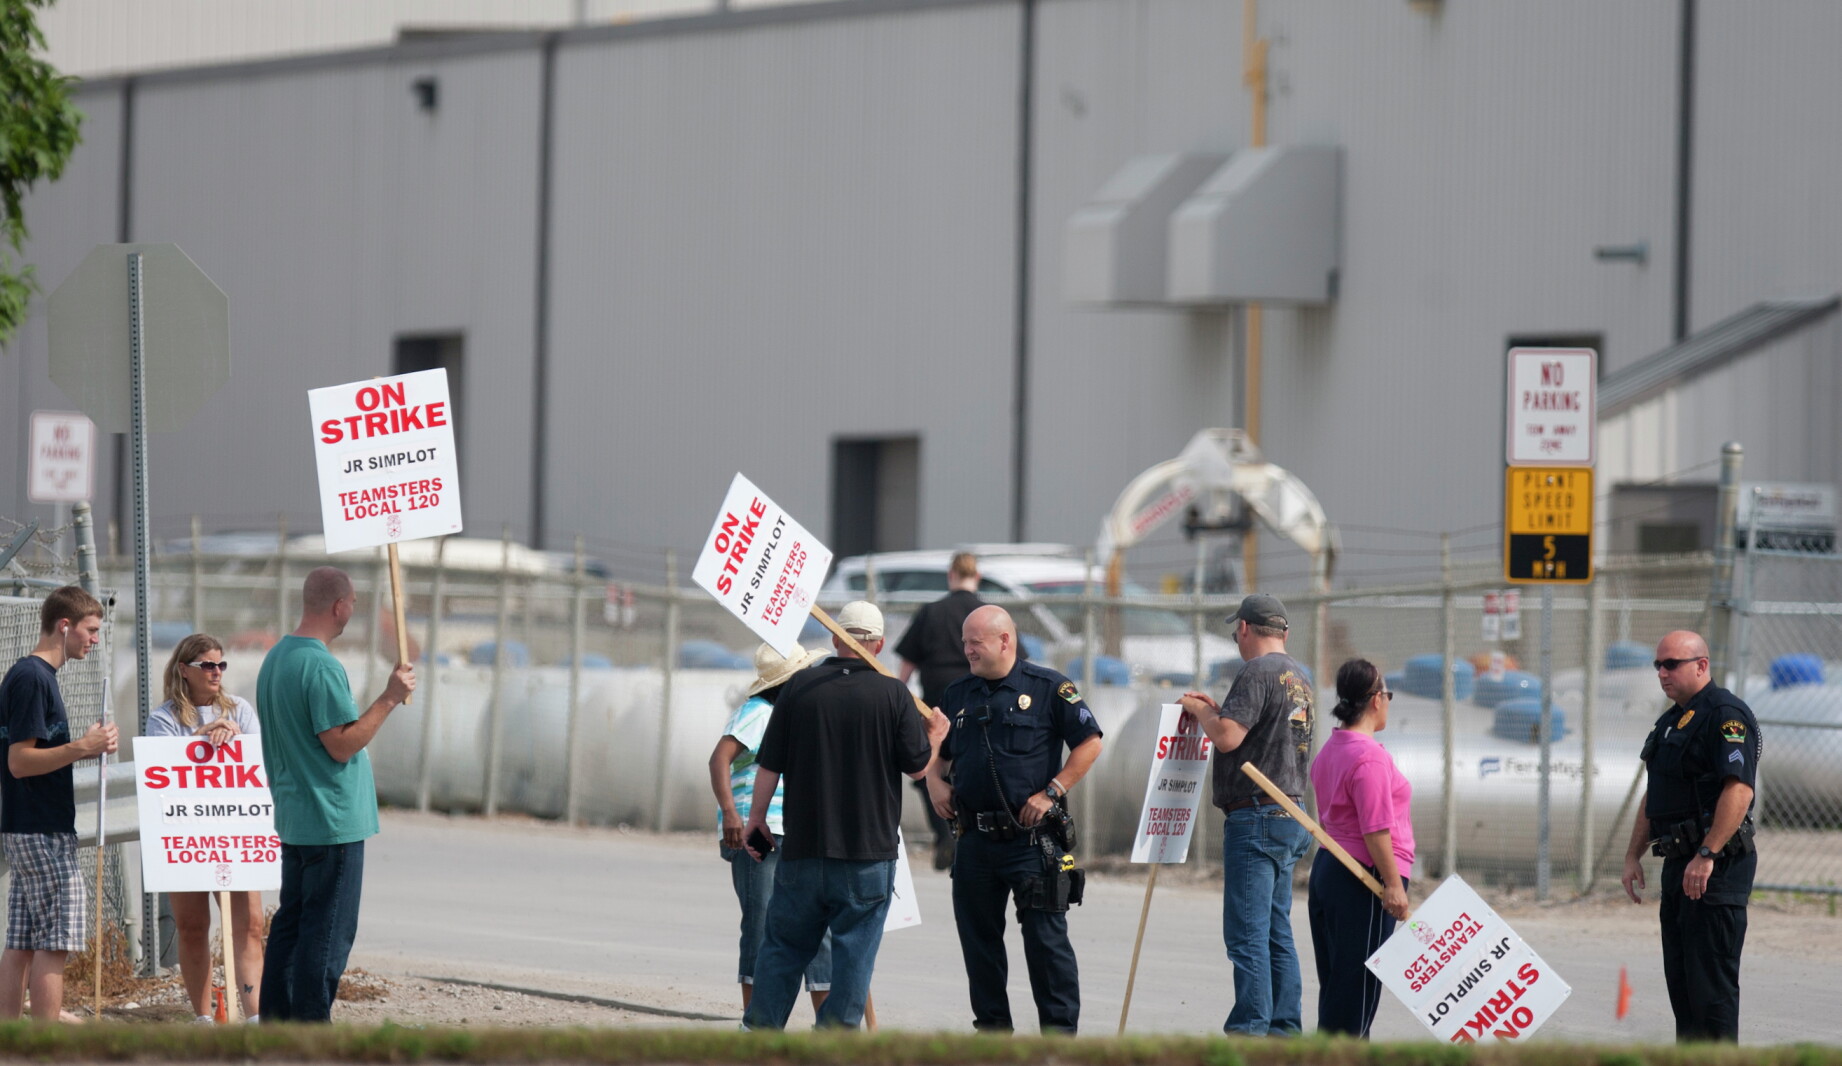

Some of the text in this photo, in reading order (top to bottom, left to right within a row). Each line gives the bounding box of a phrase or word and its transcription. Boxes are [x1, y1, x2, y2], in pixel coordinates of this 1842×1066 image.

[1541, 362, 1564, 387] NO
[355, 382, 406, 412] ON
[1523, 390, 1580, 412] PARKING
[320, 401, 447, 445] STRIKE
[344, 447, 437, 474] JR SIMPLOT
[338, 477, 443, 507] TEAMSTERS
[1523, 492, 1574, 510] SPEED
[344, 493, 440, 521] LOCAL 120
[714, 512, 740, 554] ON
[1528, 512, 1571, 529] LIMIT
[716, 496, 767, 596] STRIKE
[1543, 535, 1557, 561] 5
[739, 515, 786, 615] JR SIMPLOT
[761, 540, 801, 621] TEAMSTERS
[771, 551, 807, 626] LOCAL 120
[1178, 711, 1199, 735] ON
[185, 740, 243, 764] ON
[1157, 736, 1211, 761] STRIKE
[144, 765, 270, 789] STRIK
[1157, 778, 1197, 794] JR SIMPLOT
[165, 804, 272, 817] JR SIMPLOT
[1148, 808, 1192, 822] TEAMSTERS
[160, 835, 282, 849] TEAMSTERS
[1146, 822, 1187, 836] LOCAL 120
[167, 850, 277, 864] LOCAL 120
[1404, 912, 1472, 980] LOCAL 120
[1409, 920, 1484, 993] TEAMSTERS
[1426, 936, 1512, 1027] JR SIMPLOT
[1450, 962, 1540, 1046] STRIKE
[1493, 1006, 1534, 1045] ON
